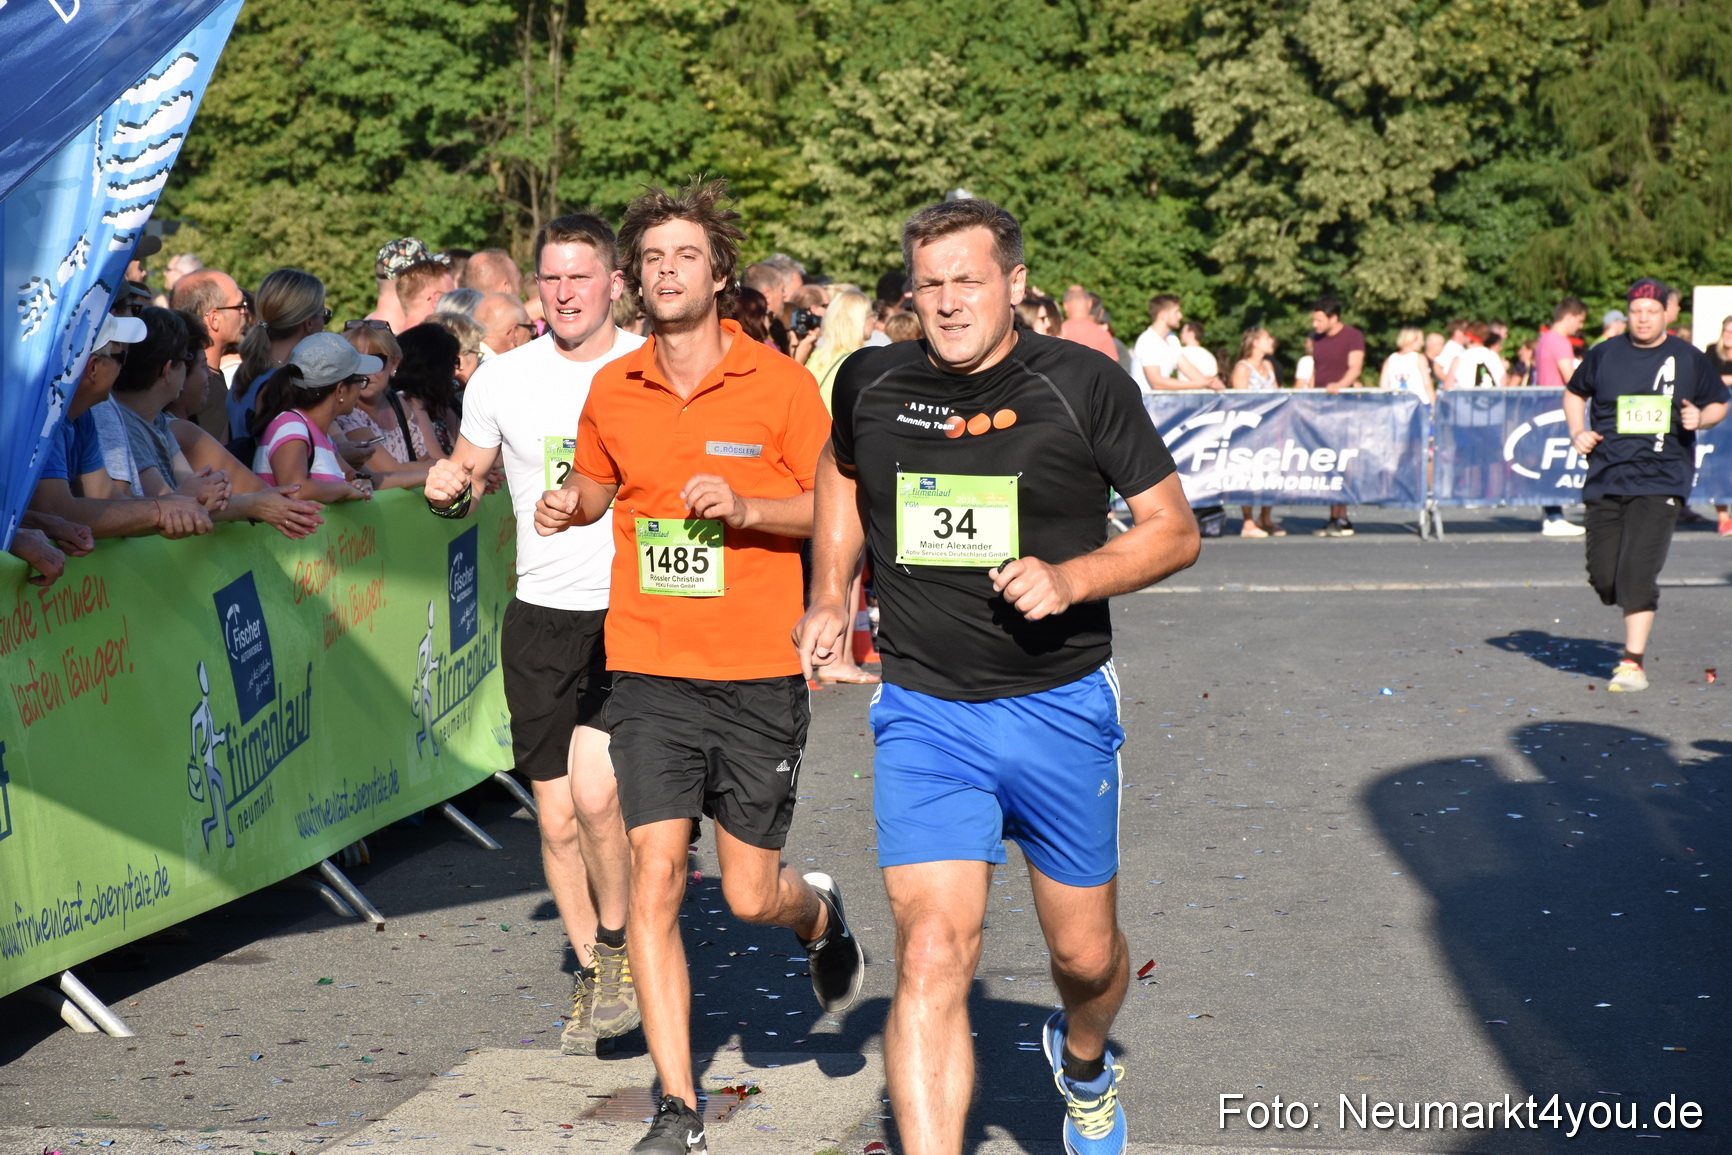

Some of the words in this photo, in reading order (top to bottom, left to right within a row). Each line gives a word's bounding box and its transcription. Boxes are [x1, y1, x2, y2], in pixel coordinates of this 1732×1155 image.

[896, 414, 931, 430] Running
[933, 421, 955, 431] Team
[909, 401, 950, 416] APTIV
[1625, 409, 1663, 423] 1612
[1190, 438, 1359, 473] Fischer
[911, 488, 952, 497] firmenlauf
[1206, 475, 1344, 491] AUTOMOBILE
[933, 507, 977, 540] 34
[645, 545, 710, 575] 1485
[919, 541, 944, 549] Maier
[946, 541, 992, 551] Alexander
[948, 550, 987, 558] Deutschland
[454, 565, 475, 595] Fischer
[671, 574, 705, 583] Christian
[37, 573, 110, 635] Firmen
[232, 618, 261, 653] Fischer
[240, 640, 263, 665] AUTOMOBILE
[436, 602, 499, 719] firmenlauf
[10, 657, 66, 729] laufen
[62, 614, 134, 705] länger!
[225, 660, 313, 804] firmenlauf
[237, 779, 275, 836] neumarkt
